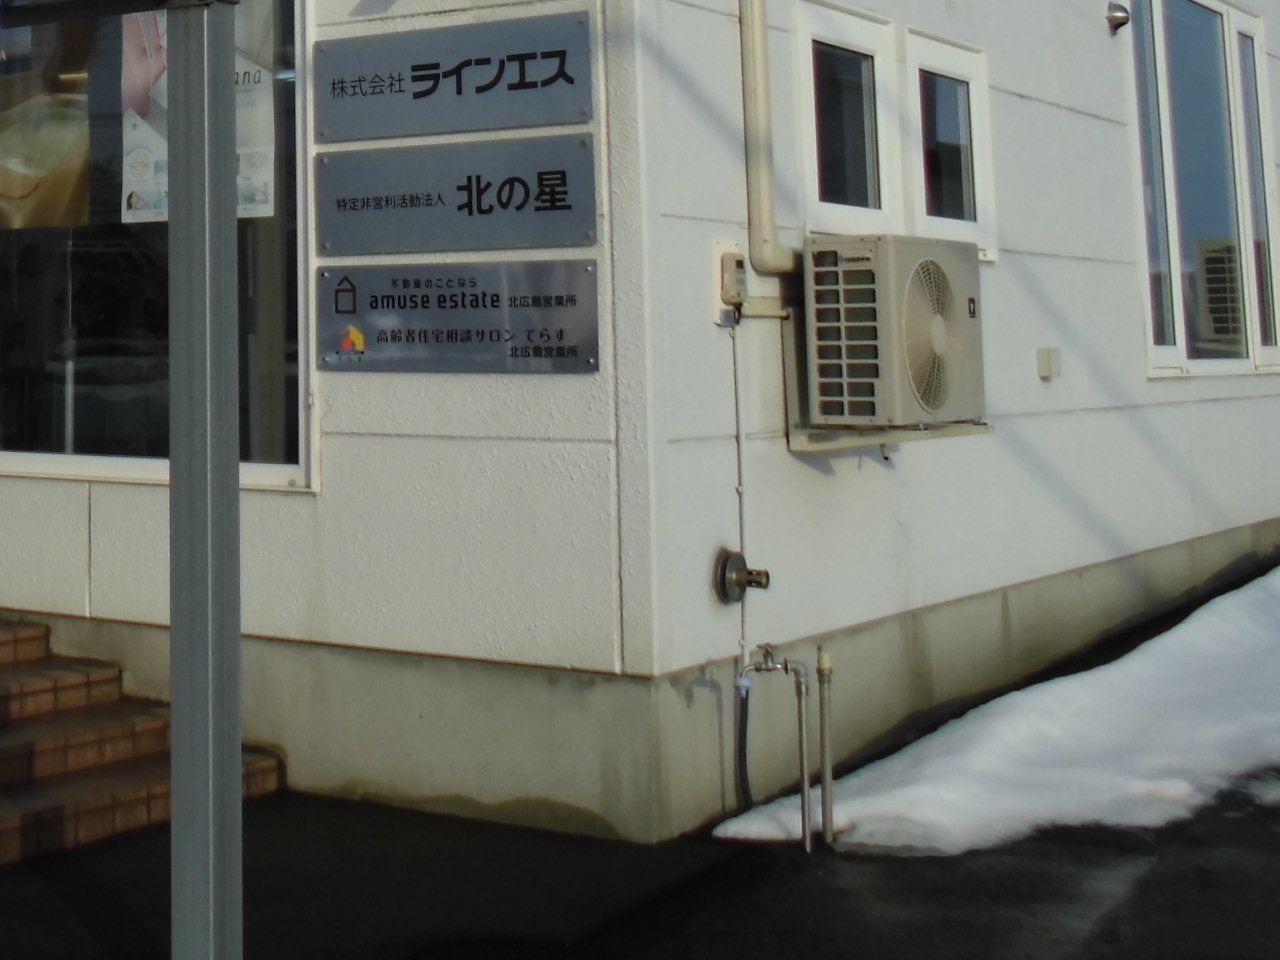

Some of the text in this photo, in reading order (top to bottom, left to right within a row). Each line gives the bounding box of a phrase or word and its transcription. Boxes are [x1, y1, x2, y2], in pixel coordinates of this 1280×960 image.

[336, 170, 572, 216] 特定非営利活動法人 北の星
[369, 294, 430, 309] amuse
[437, 290, 500, 309] estate
[524, 327, 566, 343] てらす
